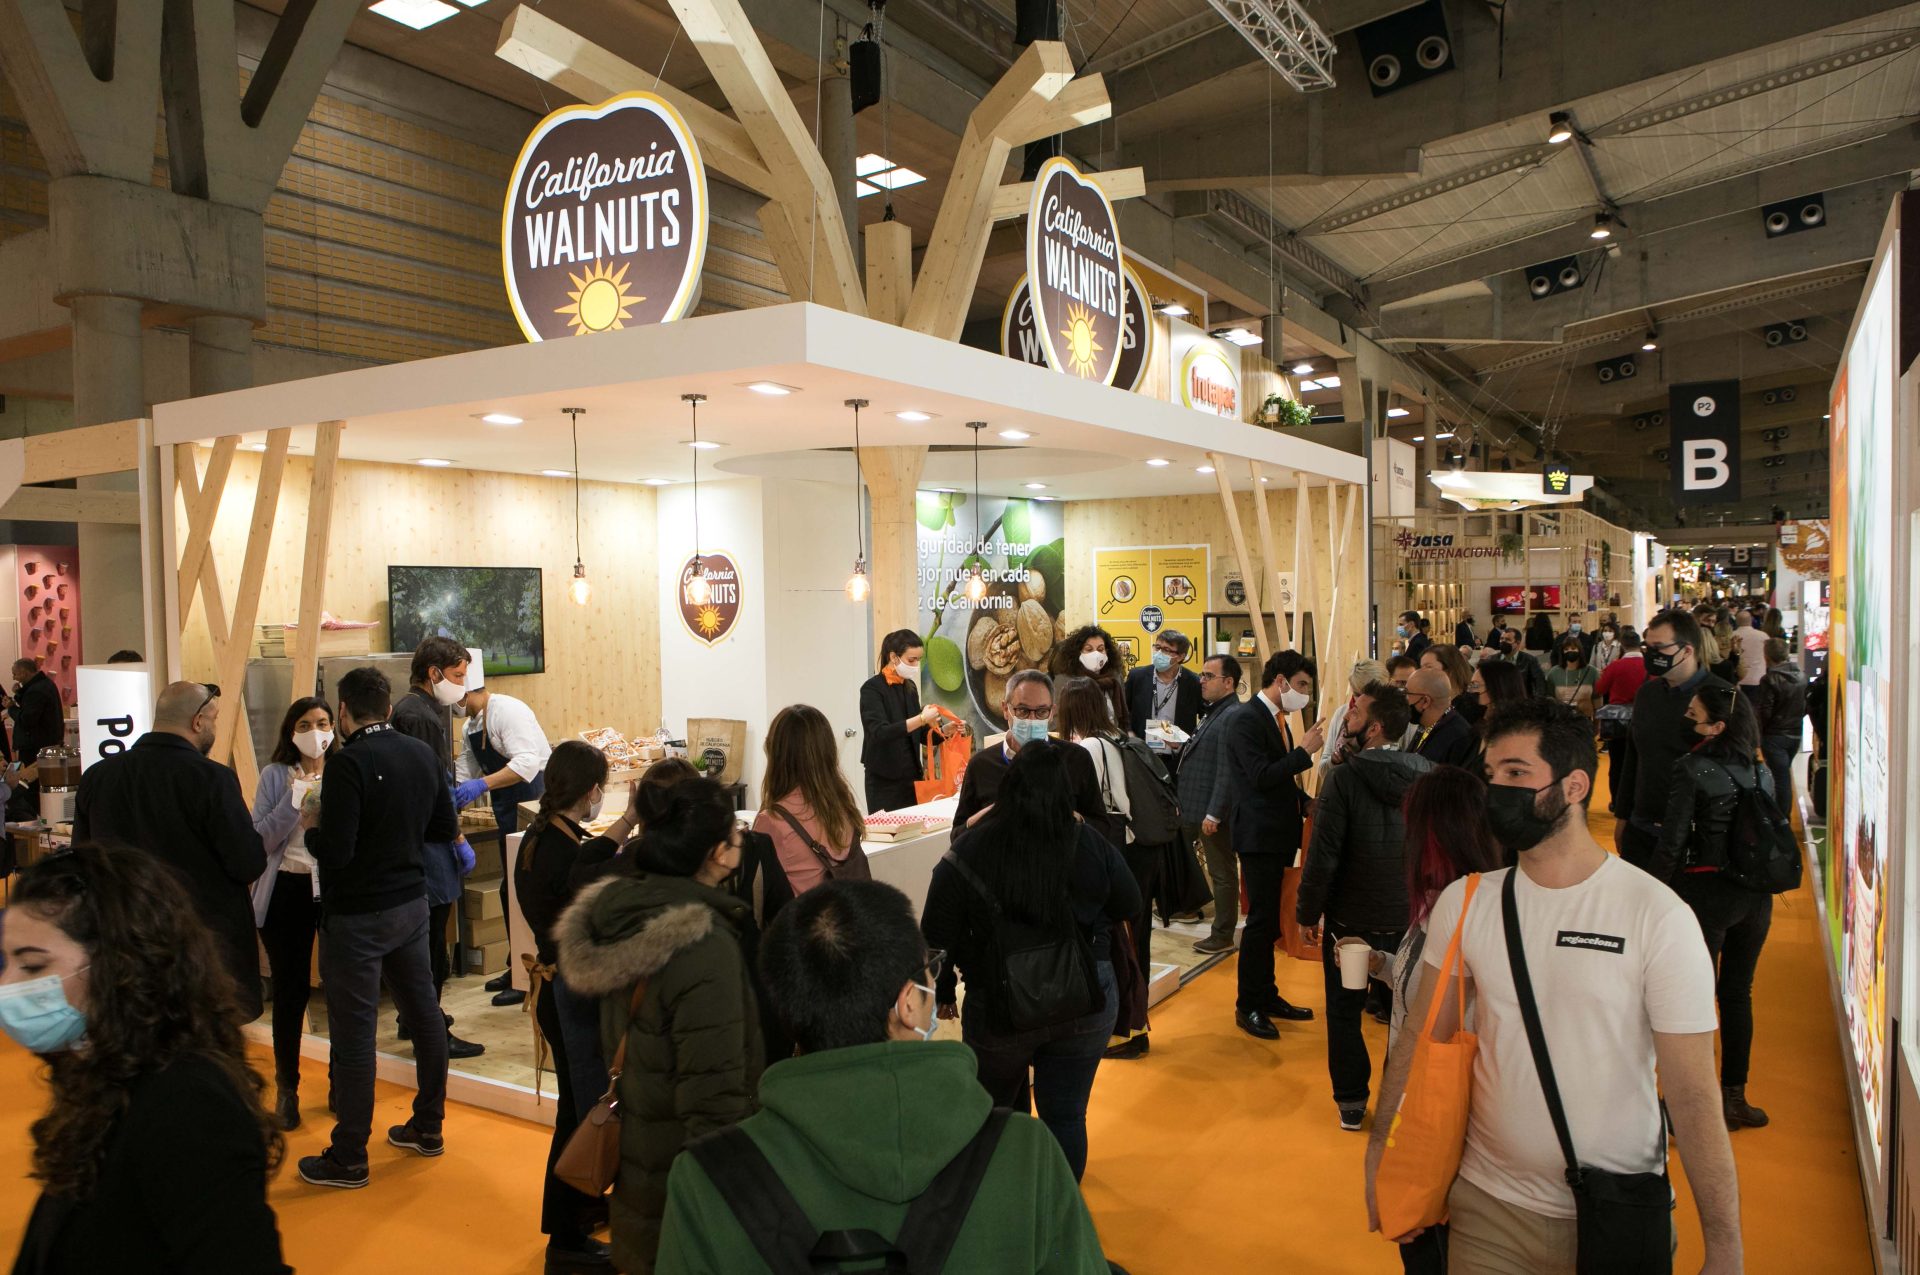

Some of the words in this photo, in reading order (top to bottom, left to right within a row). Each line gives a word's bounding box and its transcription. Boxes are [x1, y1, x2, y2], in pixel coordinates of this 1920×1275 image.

[525, 141, 676, 209] California
[525, 188, 680, 269] WALNUTS
[1045, 194, 1115, 260] California
[1045, 235, 1116, 317] WALNUTS
[1697, 402, 1712, 411] P2
[1682, 438, 1730, 491] B
[977, 534, 993, 556] de
[996, 538, 1031, 556] tener
[1734, 548, 1750, 562] B
[917, 562, 942, 587] ejor
[945, 568, 974, 582] nue
[983, 568, 998, 582] en
[1001, 562, 1030, 582] cada
[927, 588, 945, 610] de
